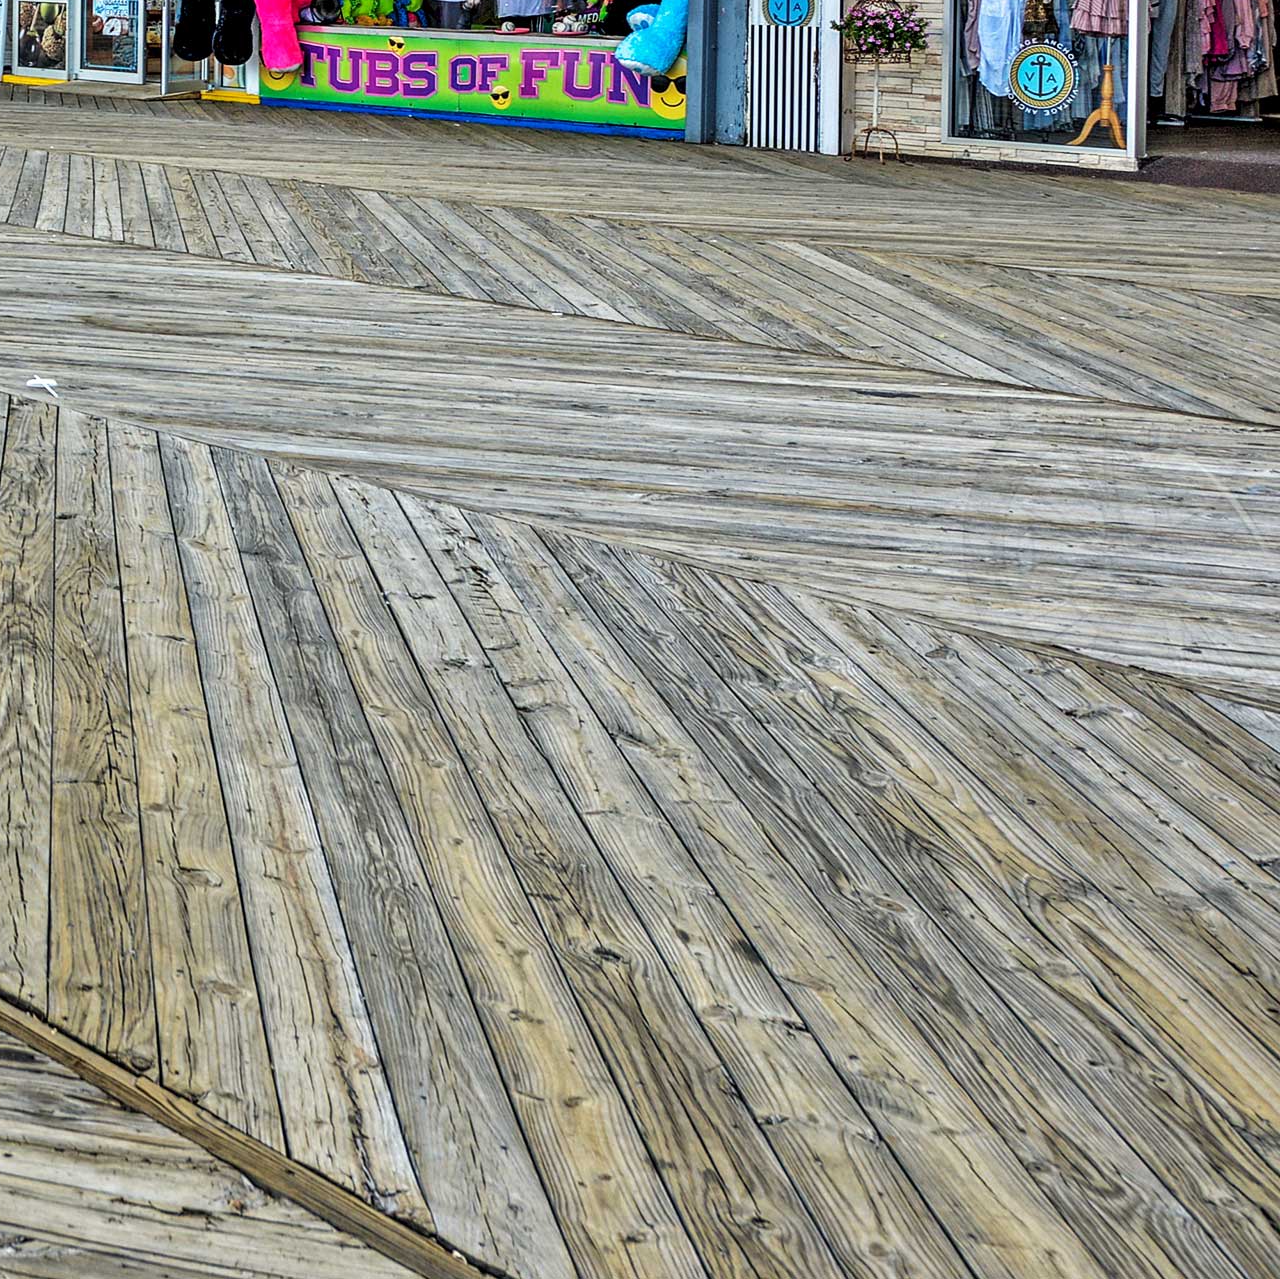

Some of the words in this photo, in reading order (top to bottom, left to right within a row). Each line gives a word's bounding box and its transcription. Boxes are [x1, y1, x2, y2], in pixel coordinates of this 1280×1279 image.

[774, 2, 783, 11] V
[792, 2, 802, 11] A
[1043, 38, 1079, 68] ANCHOR
[300, 41, 438, 99] TUBS
[450, 53, 508, 95] OF
[519, 48, 652, 109] FUN
[1024, 71, 1036, 82] V
[1046, 73, 1057, 83] A
[1043, 89, 1080, 117] VINTAGE
